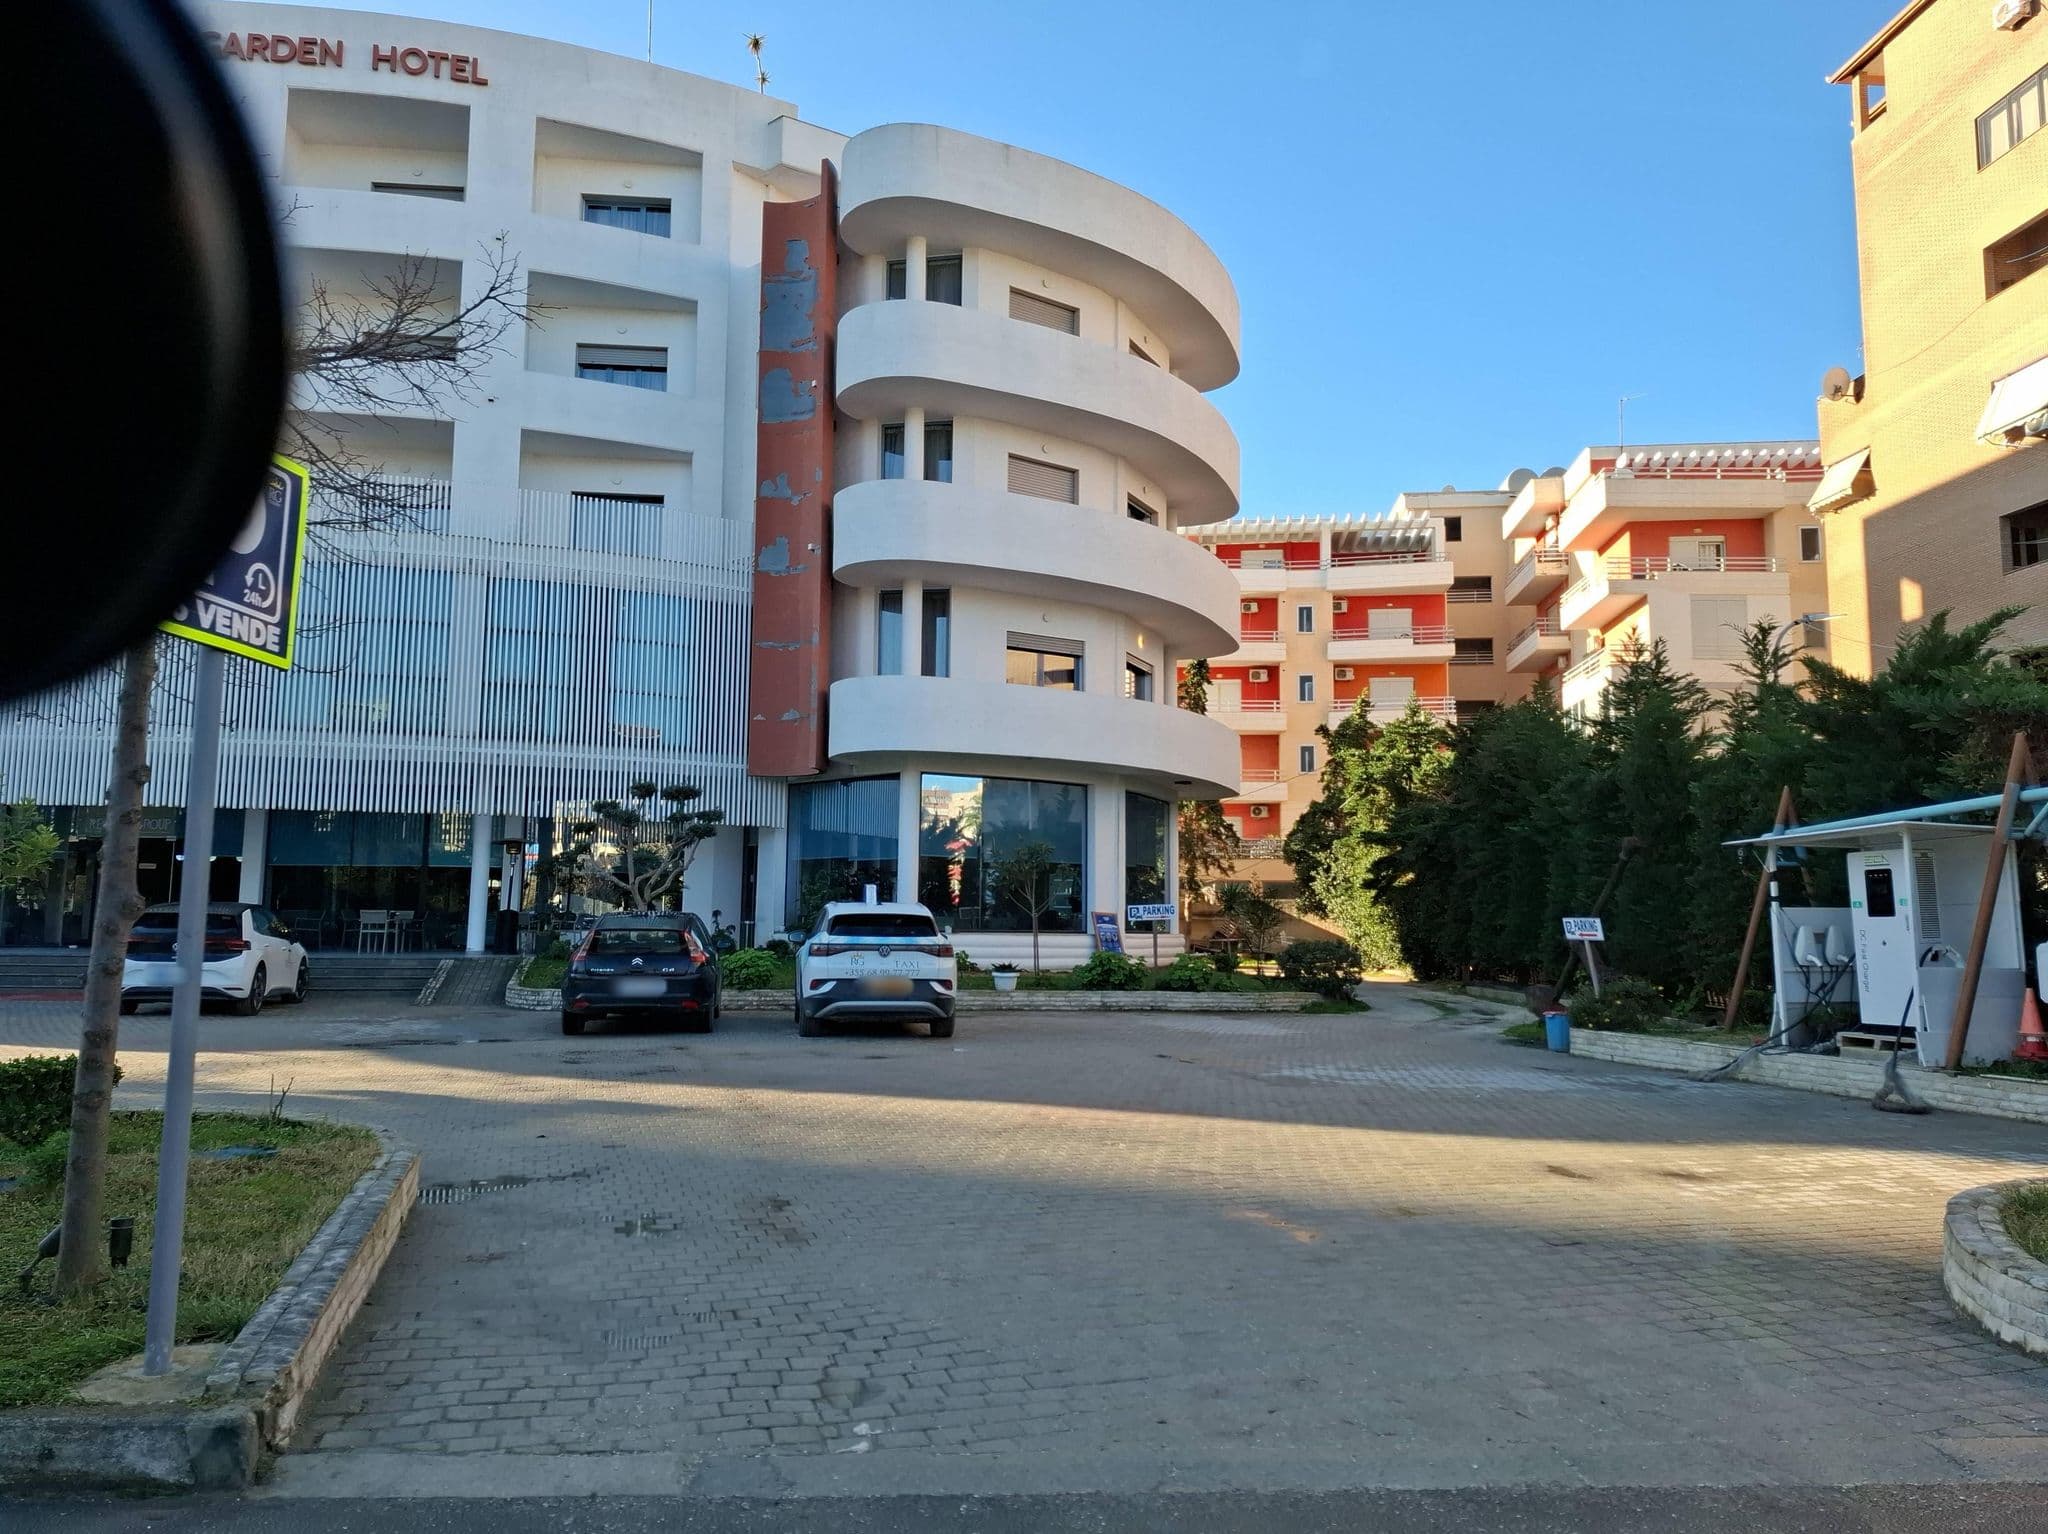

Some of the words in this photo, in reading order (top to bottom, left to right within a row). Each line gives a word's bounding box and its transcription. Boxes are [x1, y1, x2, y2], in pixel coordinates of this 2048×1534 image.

[371, 43, 489, 86] HOTEL
[243, 588, 263, 607] 24h
[195, 598, 281, 653] VENDE
[1143, 905, 1175, 916] PARKING
[1573, 920, 1598, 932] PARKING
[895, 960, 919, 969] TAXI
